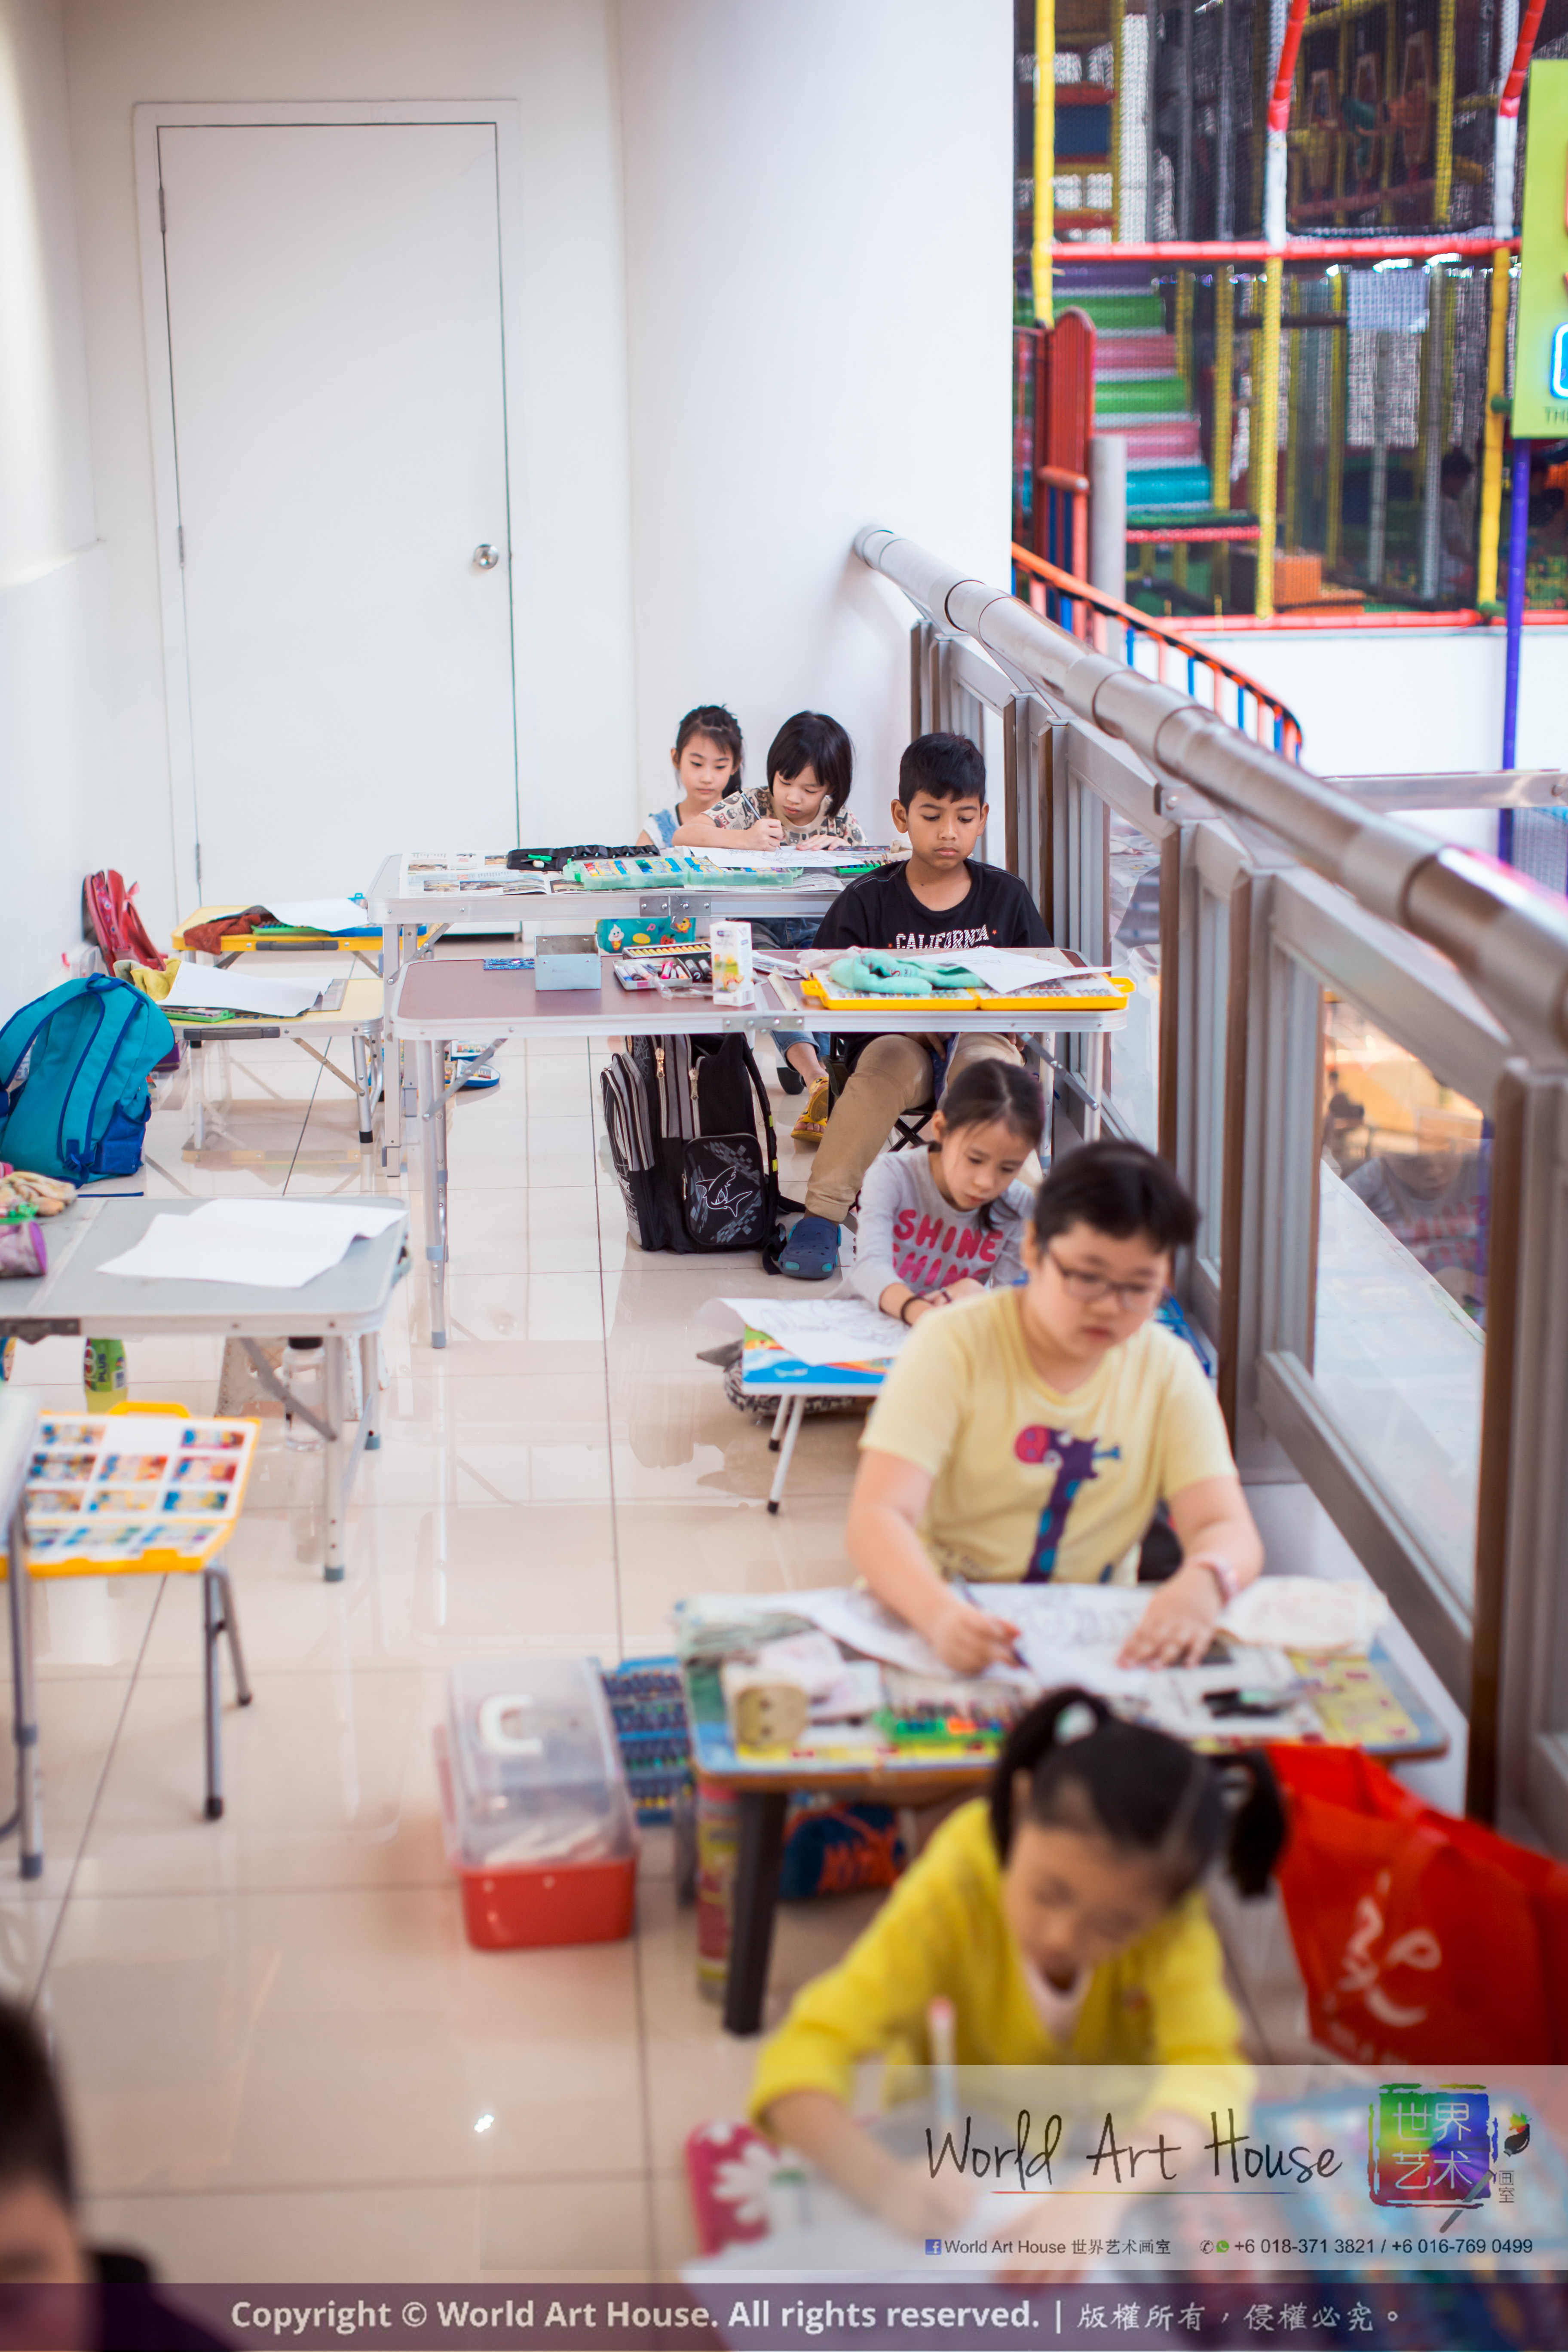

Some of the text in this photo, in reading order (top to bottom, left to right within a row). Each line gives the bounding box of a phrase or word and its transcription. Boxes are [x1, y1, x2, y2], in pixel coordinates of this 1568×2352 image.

[1543, 406, 1568, 424] TH
[896, 924, 989, 949] CALIFORNIA
[894, 1209, 1003, 1262] SHINE
[893, 1243, 991, 1288] HIN
[97, 1354, 107, 1382] PLUS
